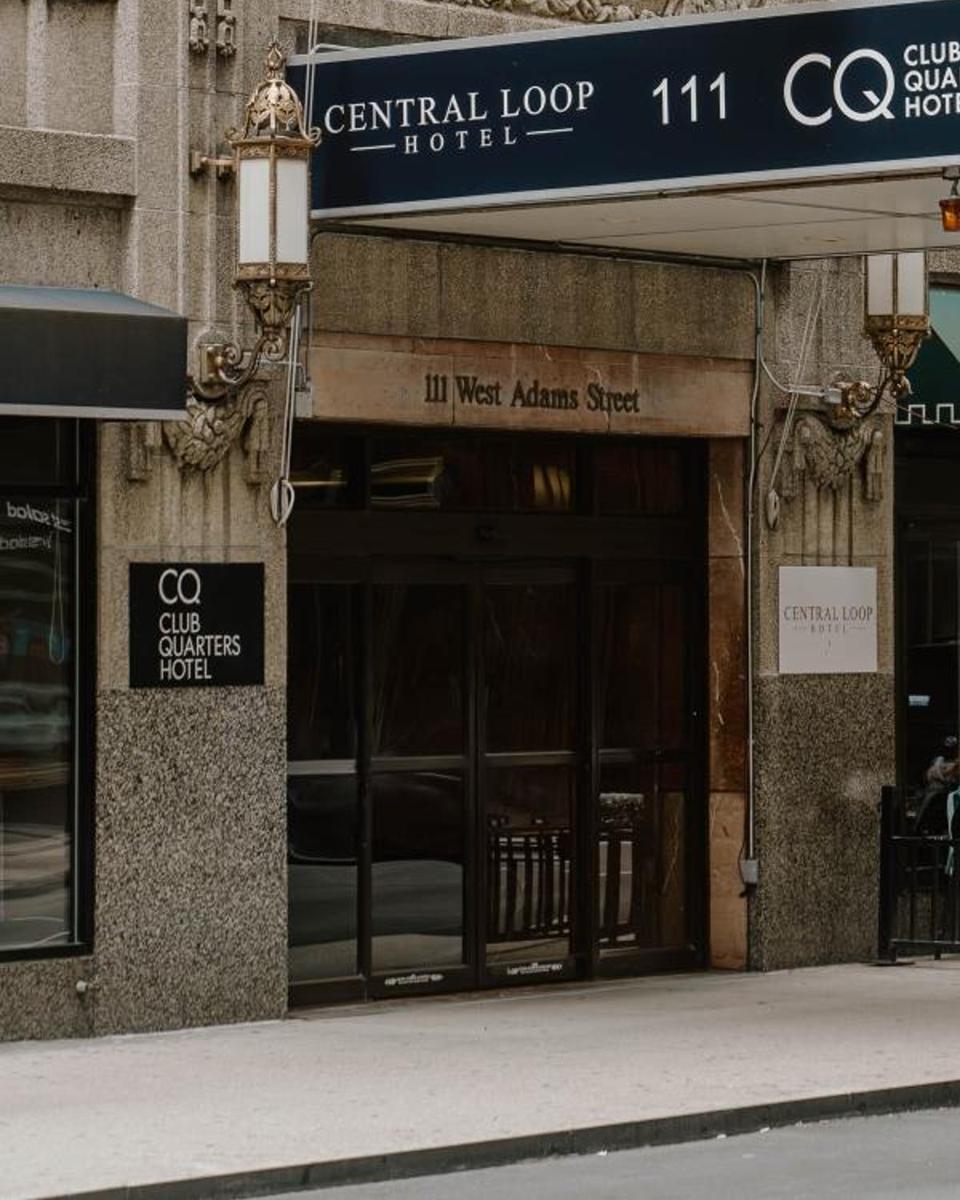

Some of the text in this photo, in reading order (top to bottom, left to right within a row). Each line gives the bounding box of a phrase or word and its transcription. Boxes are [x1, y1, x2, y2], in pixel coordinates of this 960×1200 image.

[652, 71, 727, 126] 111
[784, 48, 896, 126] CQ
[324, 80, 594, 135] CENTRAL LOOP
[405, 126, 517, 154] HOTEL
[425, 374, 640, 413] 111 West Adams Street
[158, 568, 201, 604] CQ
[159, 612, 201, 634] CLUB
[783, 606, 873, 621] CENTRAL LOOP
[159, 634, 241, 657] QUARTERS
[160, 658, 212, 680] HOTEL
